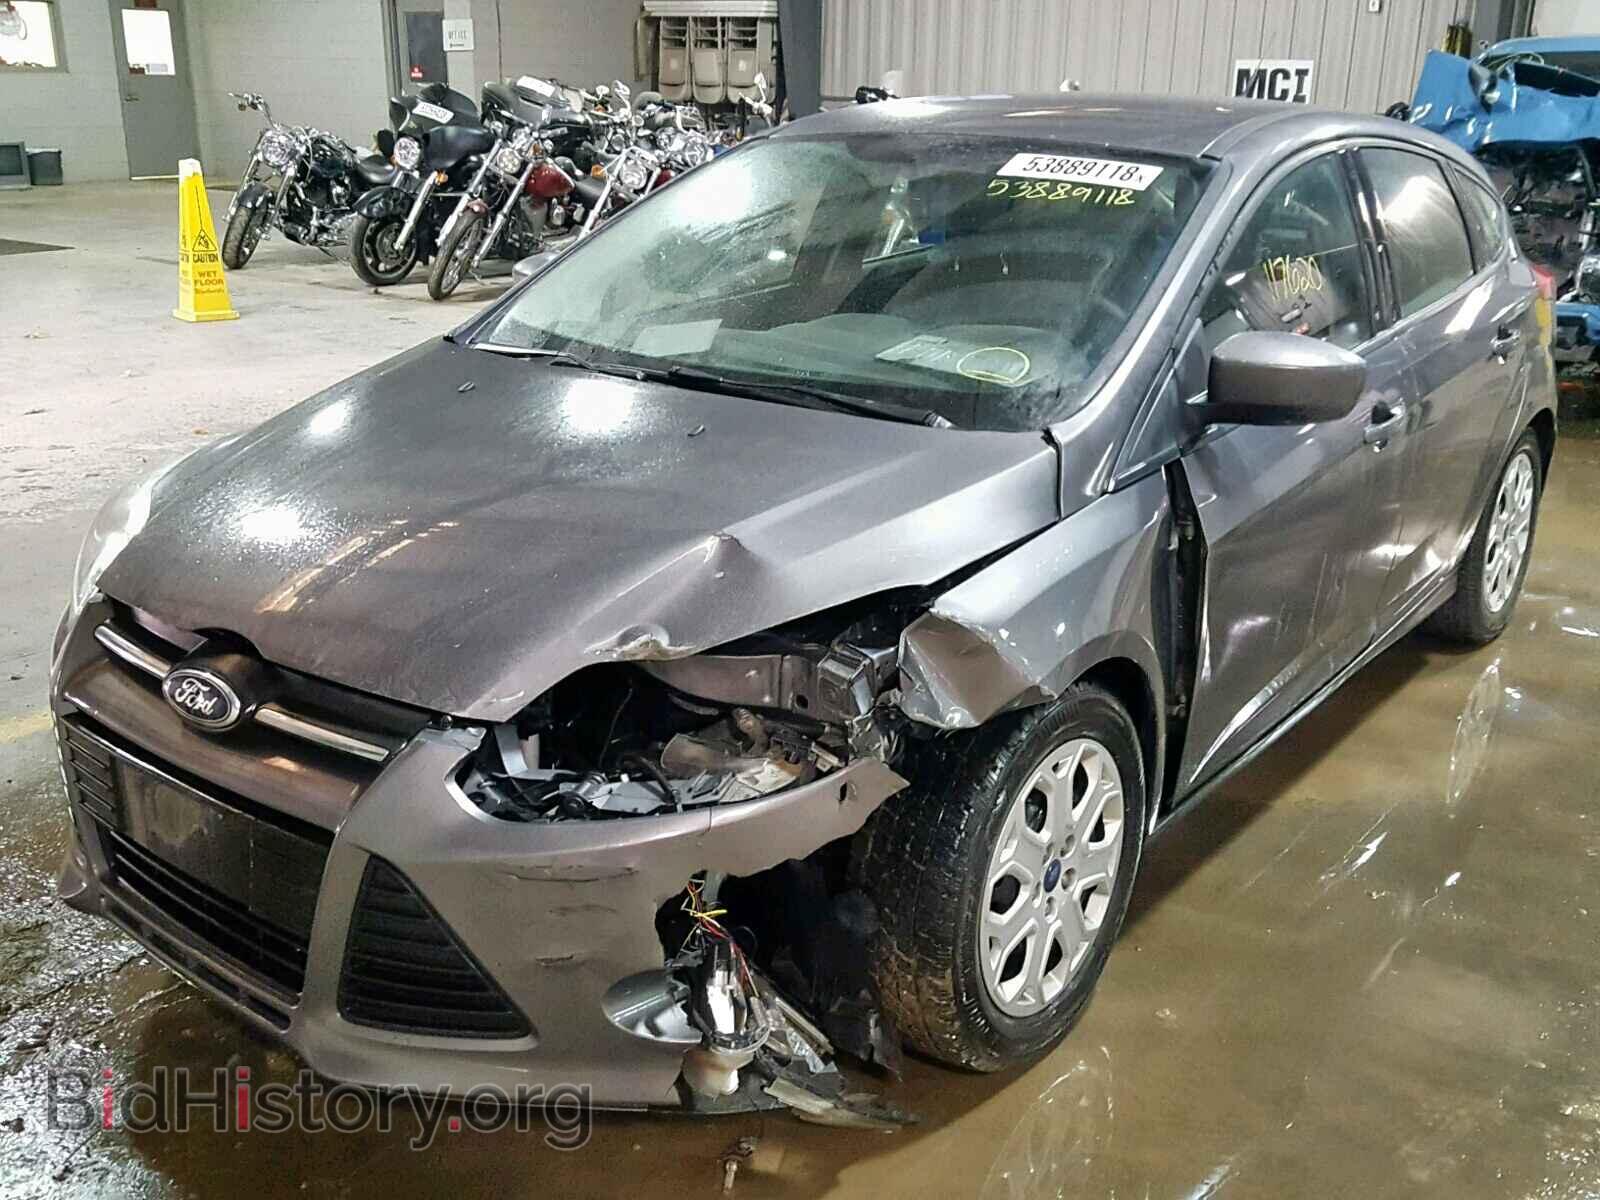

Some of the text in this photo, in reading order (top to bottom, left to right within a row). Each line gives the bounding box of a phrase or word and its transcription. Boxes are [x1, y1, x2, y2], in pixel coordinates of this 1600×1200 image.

[1235, 68, 1309, 103] MCI
[1022, 156, 1140, 182] 53889118
[987, 179, 1136, 207] 53889118
[192, 253, 219, 263] CAUTION
[194, 279, 224, 287] FLOOR
[198, 270, 217, 278] WET
[174, 678, 218, 715] Ford
